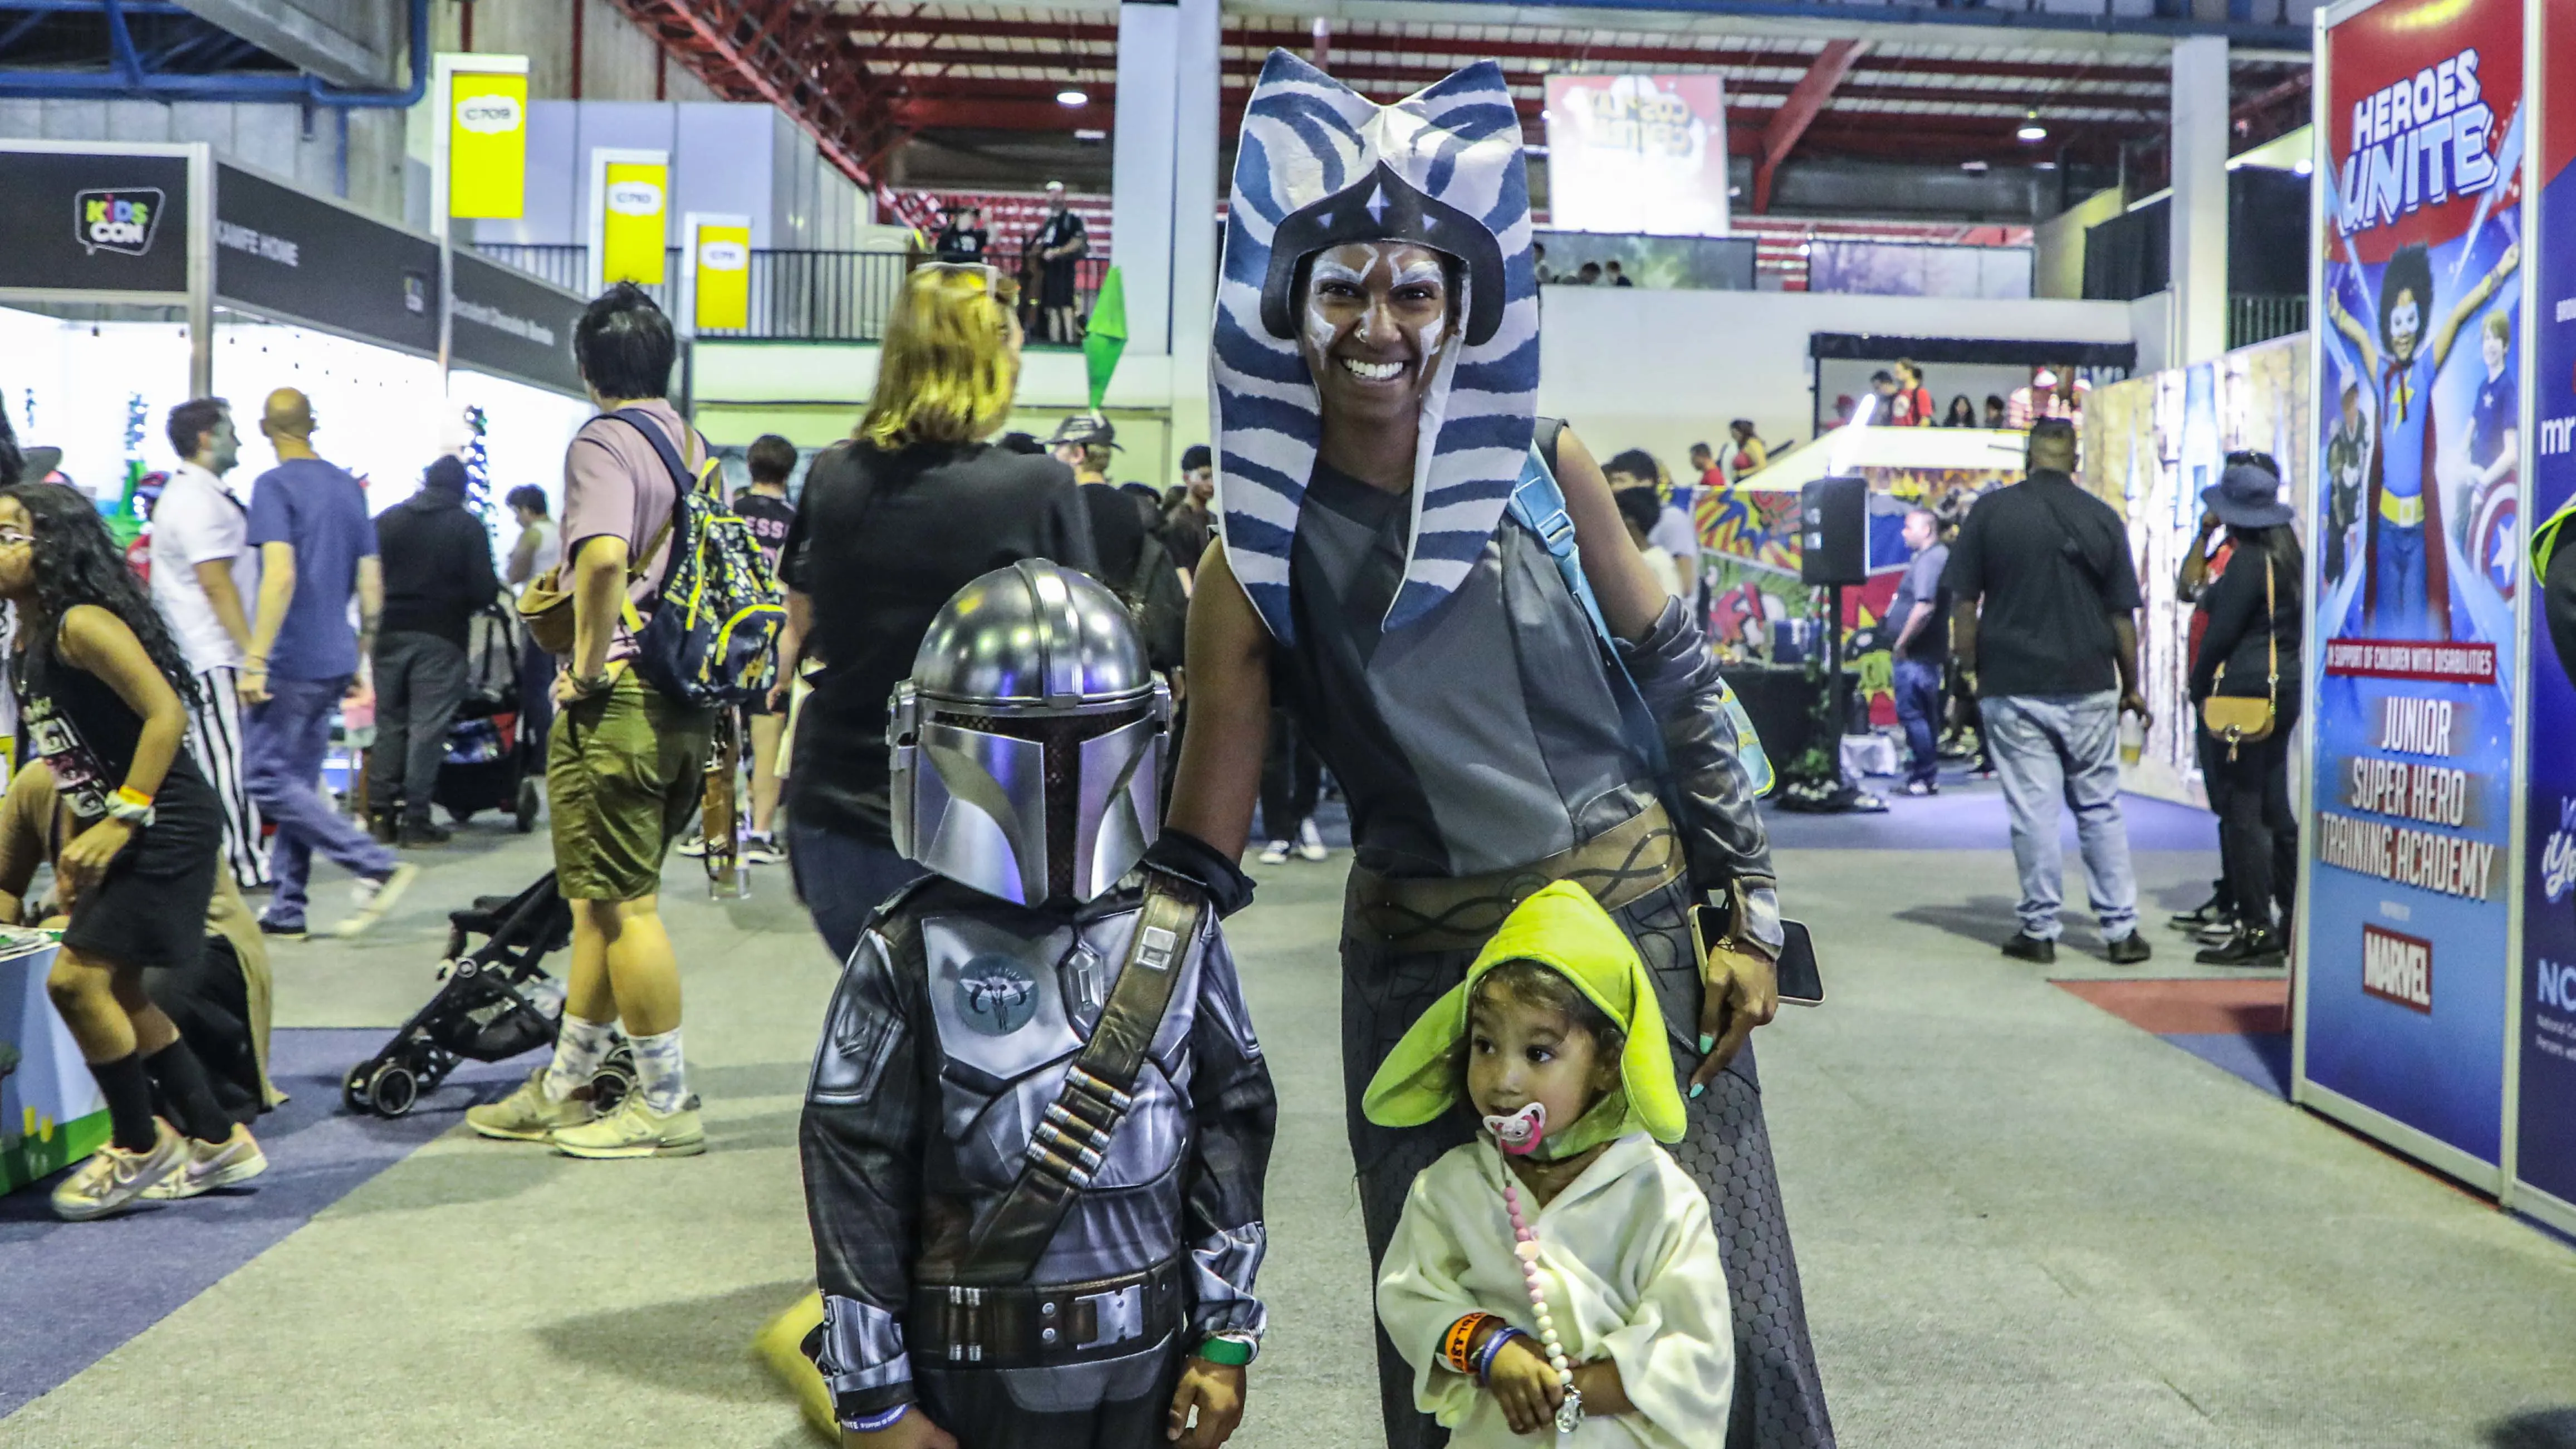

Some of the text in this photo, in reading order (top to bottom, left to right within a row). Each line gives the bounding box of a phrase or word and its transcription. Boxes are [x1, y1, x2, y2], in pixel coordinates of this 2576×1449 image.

[2352, 47, 2481, 153] HEROES
[2338, 102, 2498, 238] UNITE
[90, 221, 145, 243] CON
[2434, 648, 2492, 675] DISABILITIES
[2381, 696, 2451, 757] JUNIOR
[2352, 756, 2466, 827] SUPER HERO
[2322, 811, 2494, 901] TRAINING ACADEMY
[2364, 931, 2431, 1005] MARVEL
